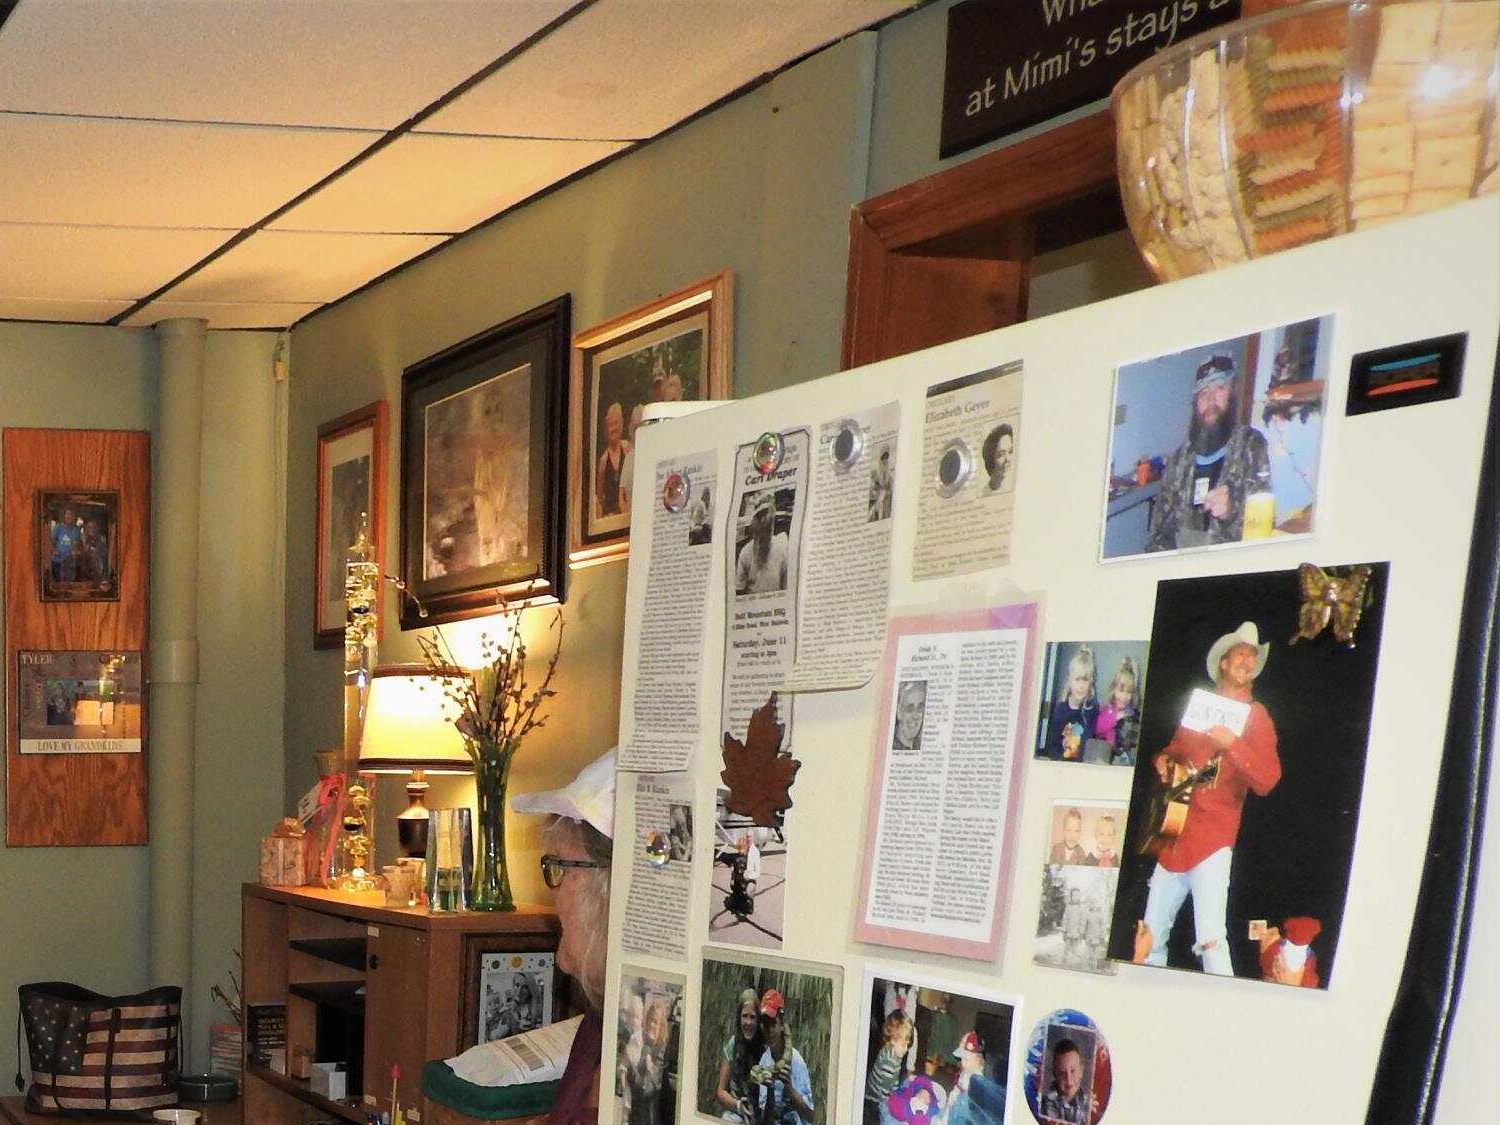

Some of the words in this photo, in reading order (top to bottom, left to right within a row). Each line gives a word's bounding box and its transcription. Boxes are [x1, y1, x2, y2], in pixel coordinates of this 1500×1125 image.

[965, 77, 996, 117] at
[1003, 37, 1097, 100] Mimi's
[1105, 0, 1198, 55] stays
[37, 741, 59, 751] LOVE
[61, 741, 73, 751] MY
